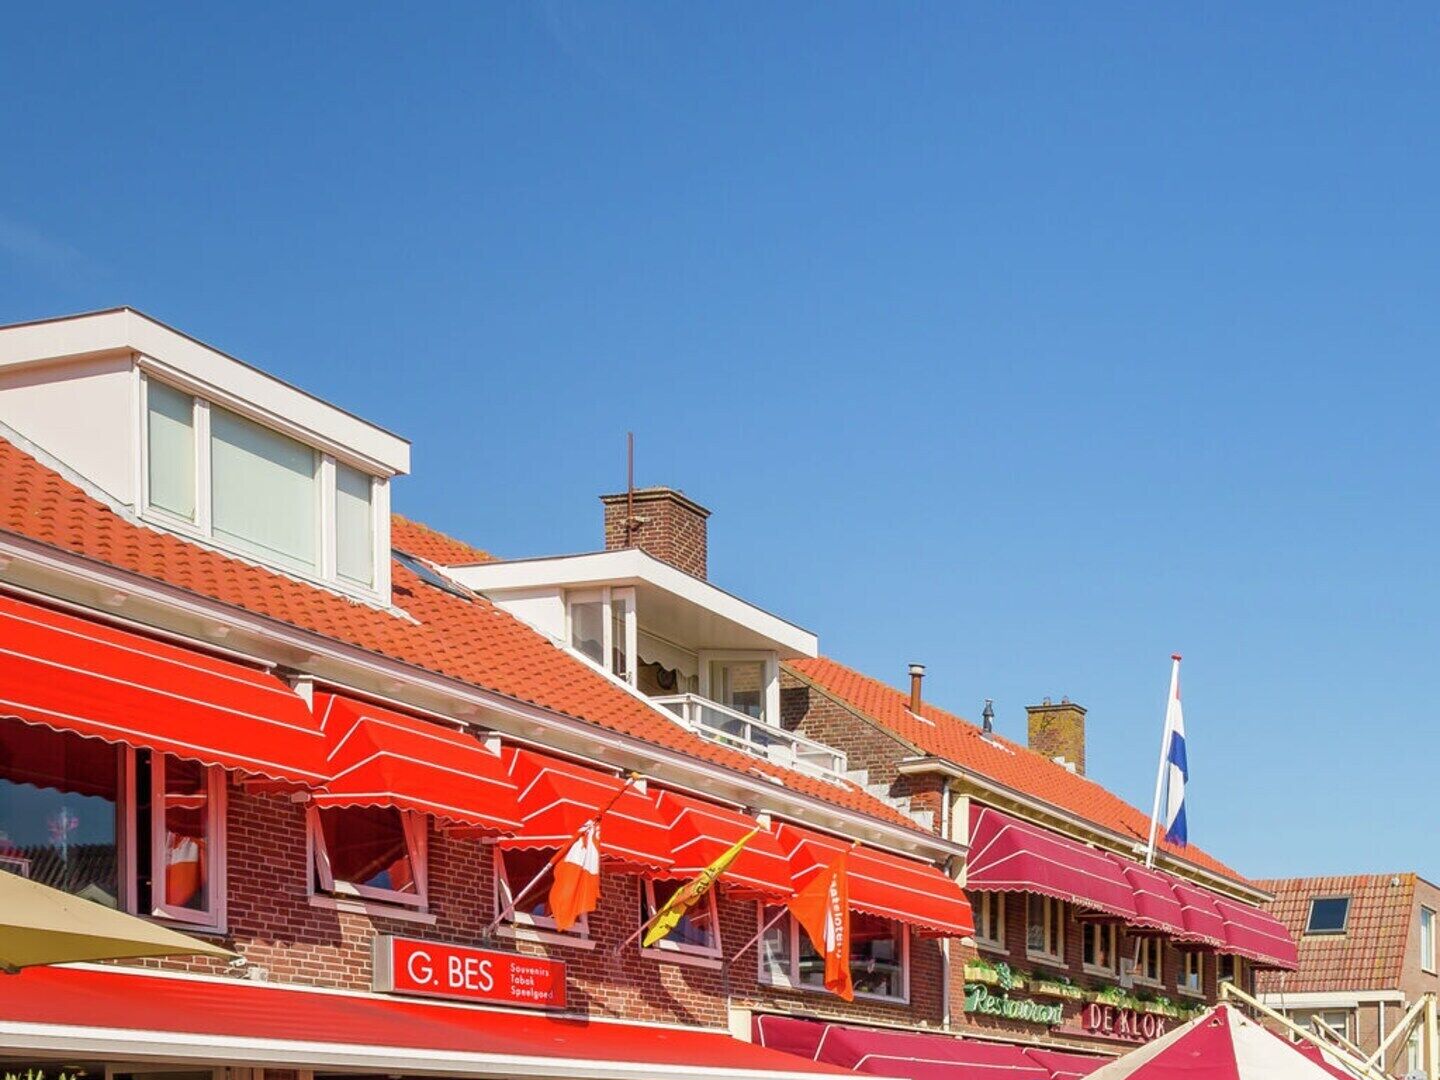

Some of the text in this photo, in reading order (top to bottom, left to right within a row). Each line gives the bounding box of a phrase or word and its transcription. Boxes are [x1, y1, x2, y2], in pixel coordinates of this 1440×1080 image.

[407, 950, 493, 992] G. BES
[510, 962, 549, 977] Souvenirs
[511, 974, 534, 986] Tabak
[511, 985, 553, 1000] Speelgoed
[964, 983, 1166, 1039] Restaurant DE KLOK
